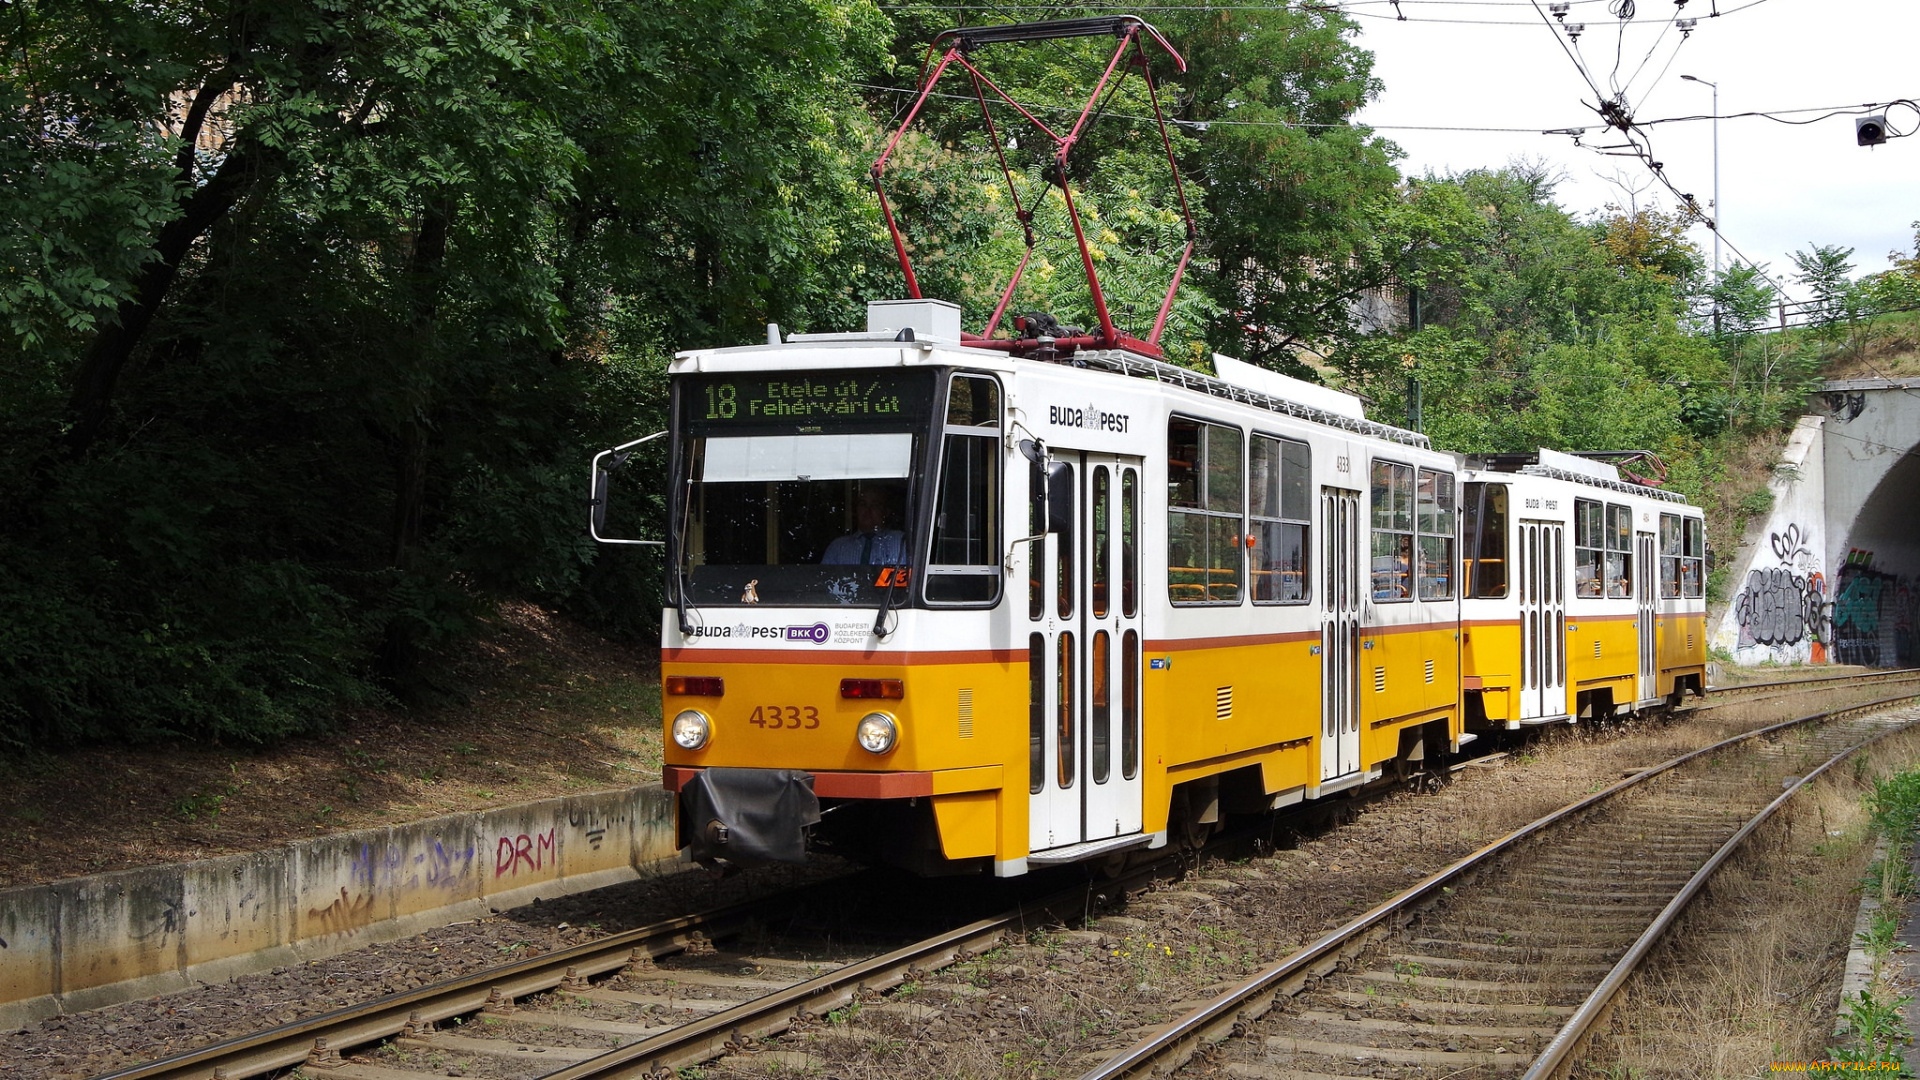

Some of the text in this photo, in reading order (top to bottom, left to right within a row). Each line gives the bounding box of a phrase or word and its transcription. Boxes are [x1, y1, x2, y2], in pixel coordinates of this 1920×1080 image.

[767, 381, 828, 398] Etele
[705, 383, 737, 419] 18
[750, 396, 900, 416] Fehérvári út
[790, 629, 811, 638] BKK
[834, 622, 870, 630] BUDAPESTI
[749, 705, 820, 730] 4333
[495, 827, 556, 878] DRM
